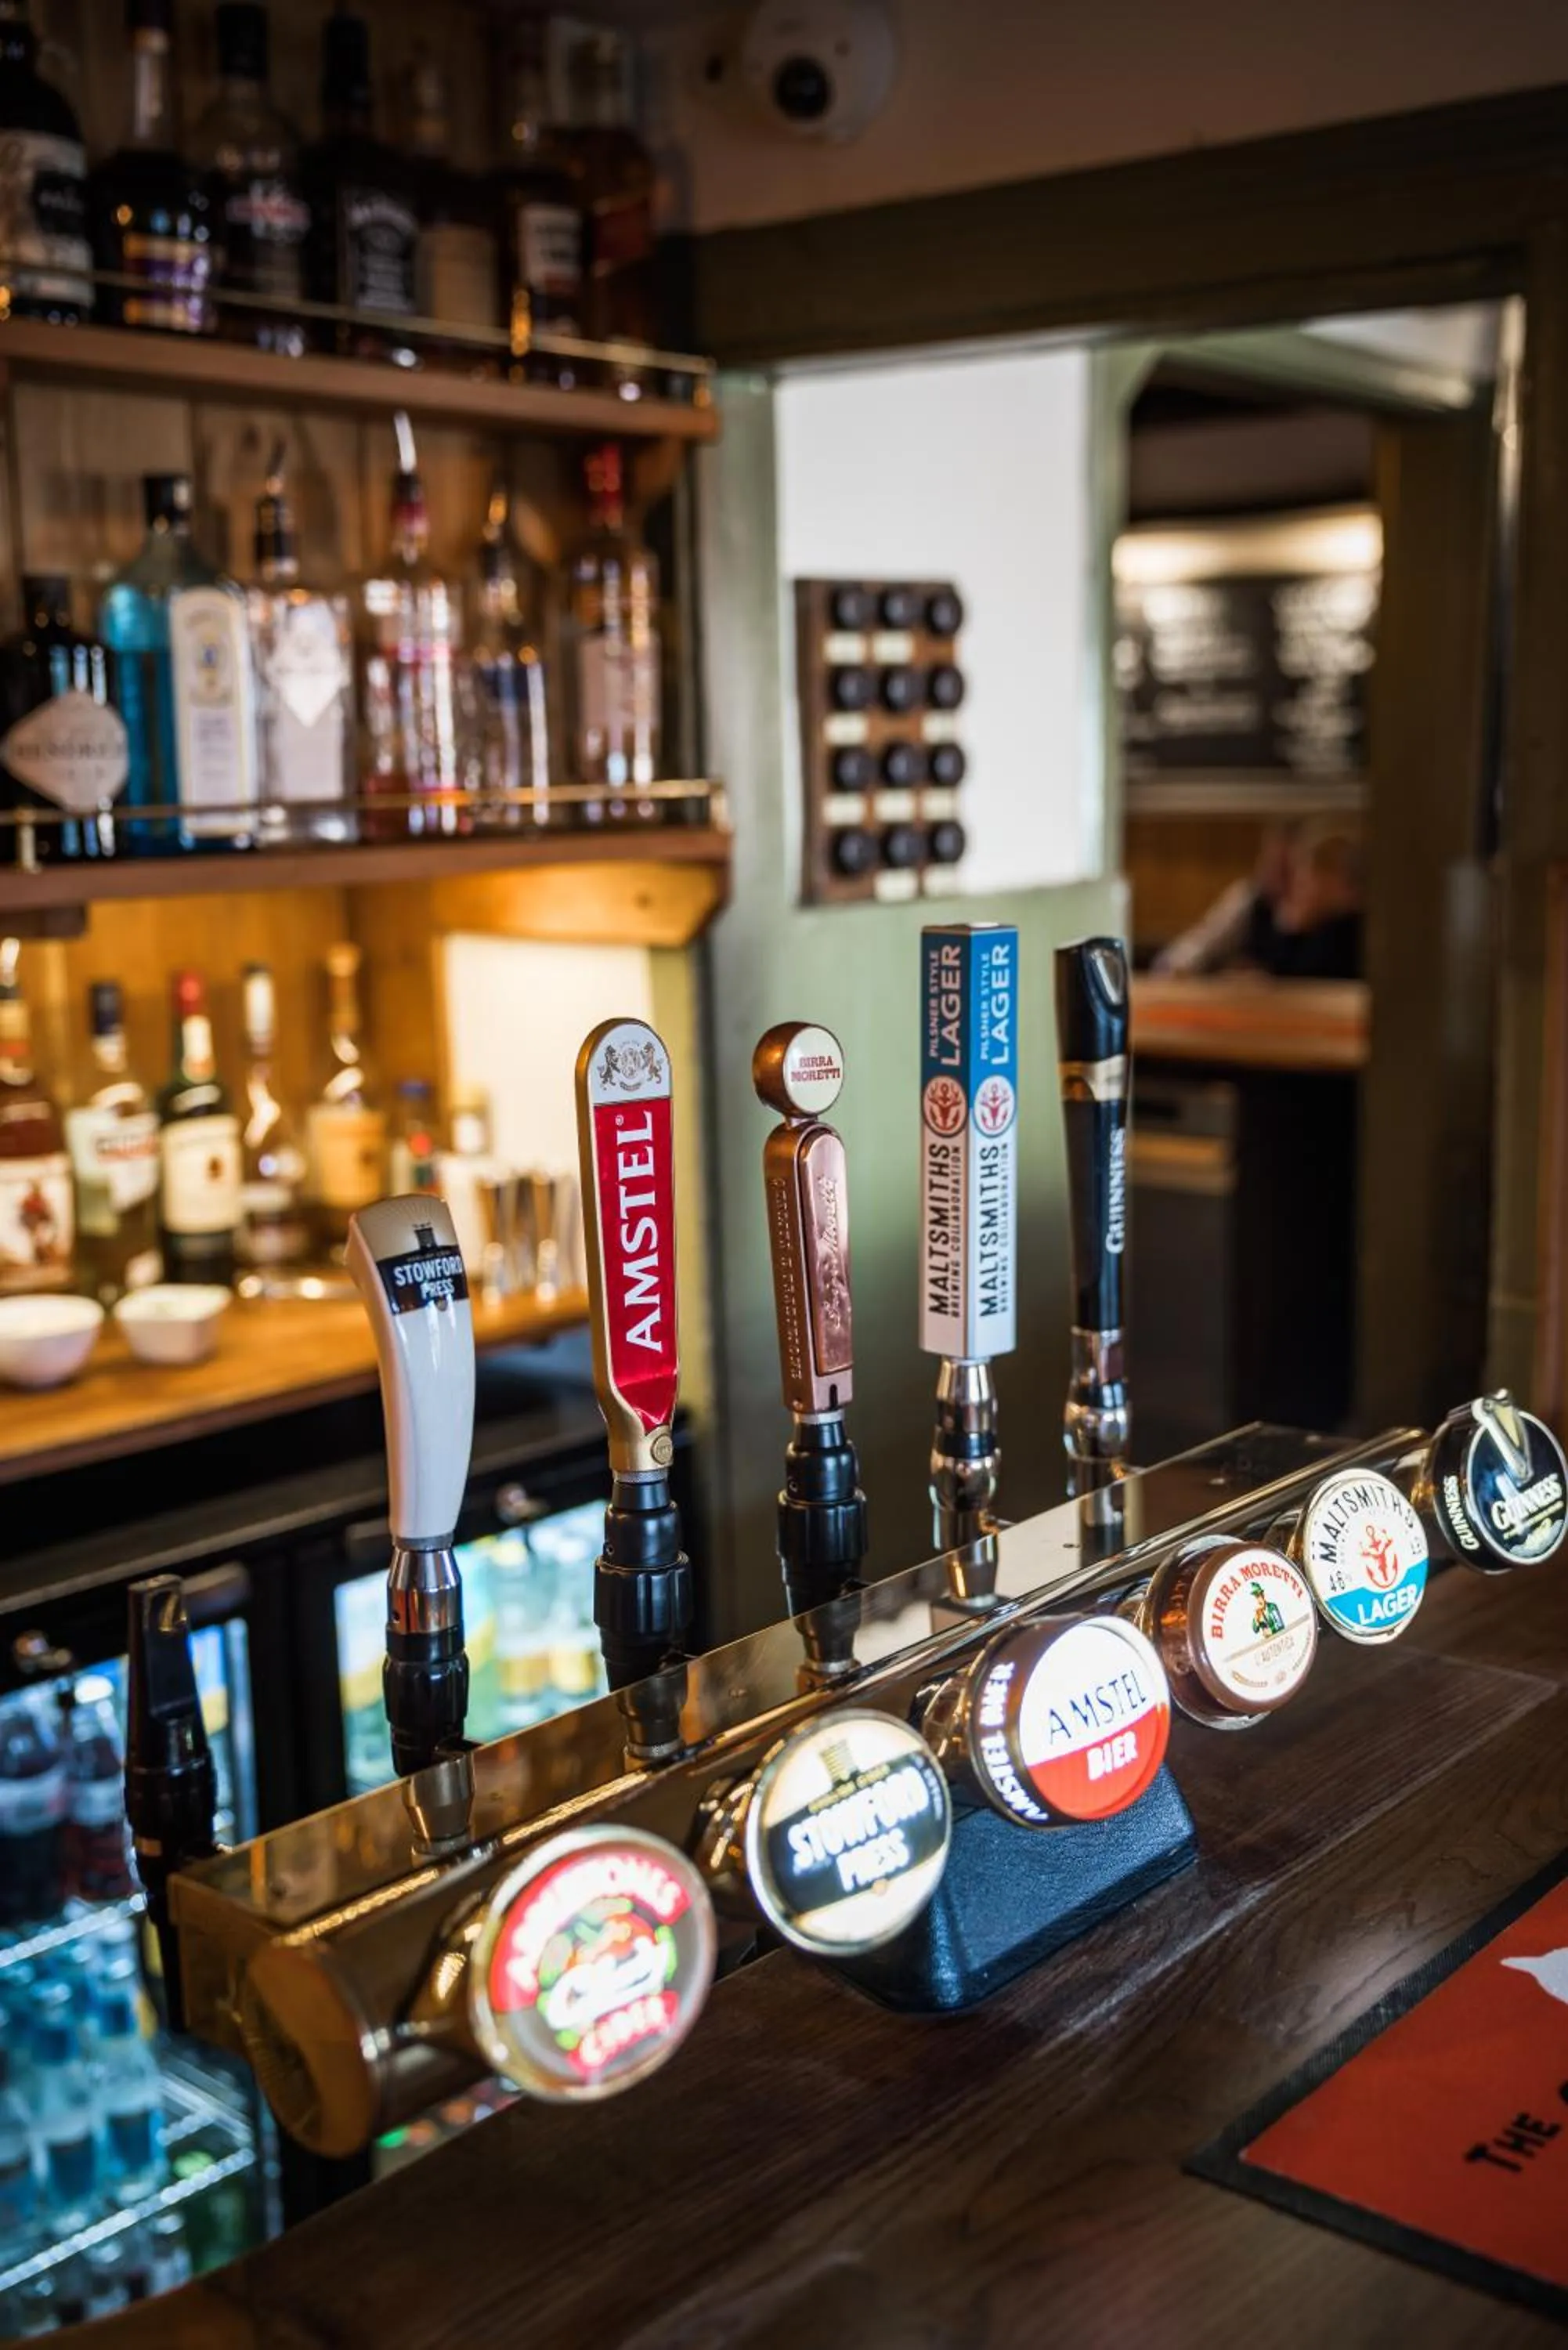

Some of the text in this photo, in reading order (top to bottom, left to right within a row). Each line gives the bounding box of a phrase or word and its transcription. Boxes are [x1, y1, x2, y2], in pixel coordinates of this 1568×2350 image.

[930, 950, 939, 1058] PILSNER STYLE
[941, 945, 961, 1065] LAGER
[981, 953, 990, 1060] PILSNER STYLE
[991, 944, 1010, 1065] LAGER
[791, 1068, 840, 1082] MORETTI
[800, 1056, 833, 1068] BIRRA
[928, 1143, 950, 1315] MALTSMITHS
[1105, 1127, 1125, 1253] GUINNESS
[616, 1110, 661, 1353] AMSTEL
[950, 1147, 960, 1318] BREWING COLLABORATION
[979, 1146, 999, 1317] MALTSMITHS
[394, 1256, 463, 1286] STOWFORD
[421, 1278, 454, 1300] PRESS
[1319, 1484, 1413, 1564] MALTSMITHS
[1443, 1475, 1479, 1550] GUINNESS
[1491, 1473, 1563, 1530] GUINNESS
[1212, 1562, 1303, 1639] BIRRA MORETTI
[1357, 1583, 1418, 1625] LAGER
[1049, 1670, 1147, 1744] AMSTEL
[981, 1730, 1048, 1819] AMSTEL
[1086, 1730, 1138, 1781] BIER
[1464, 2113, 1560, 2173] THE
